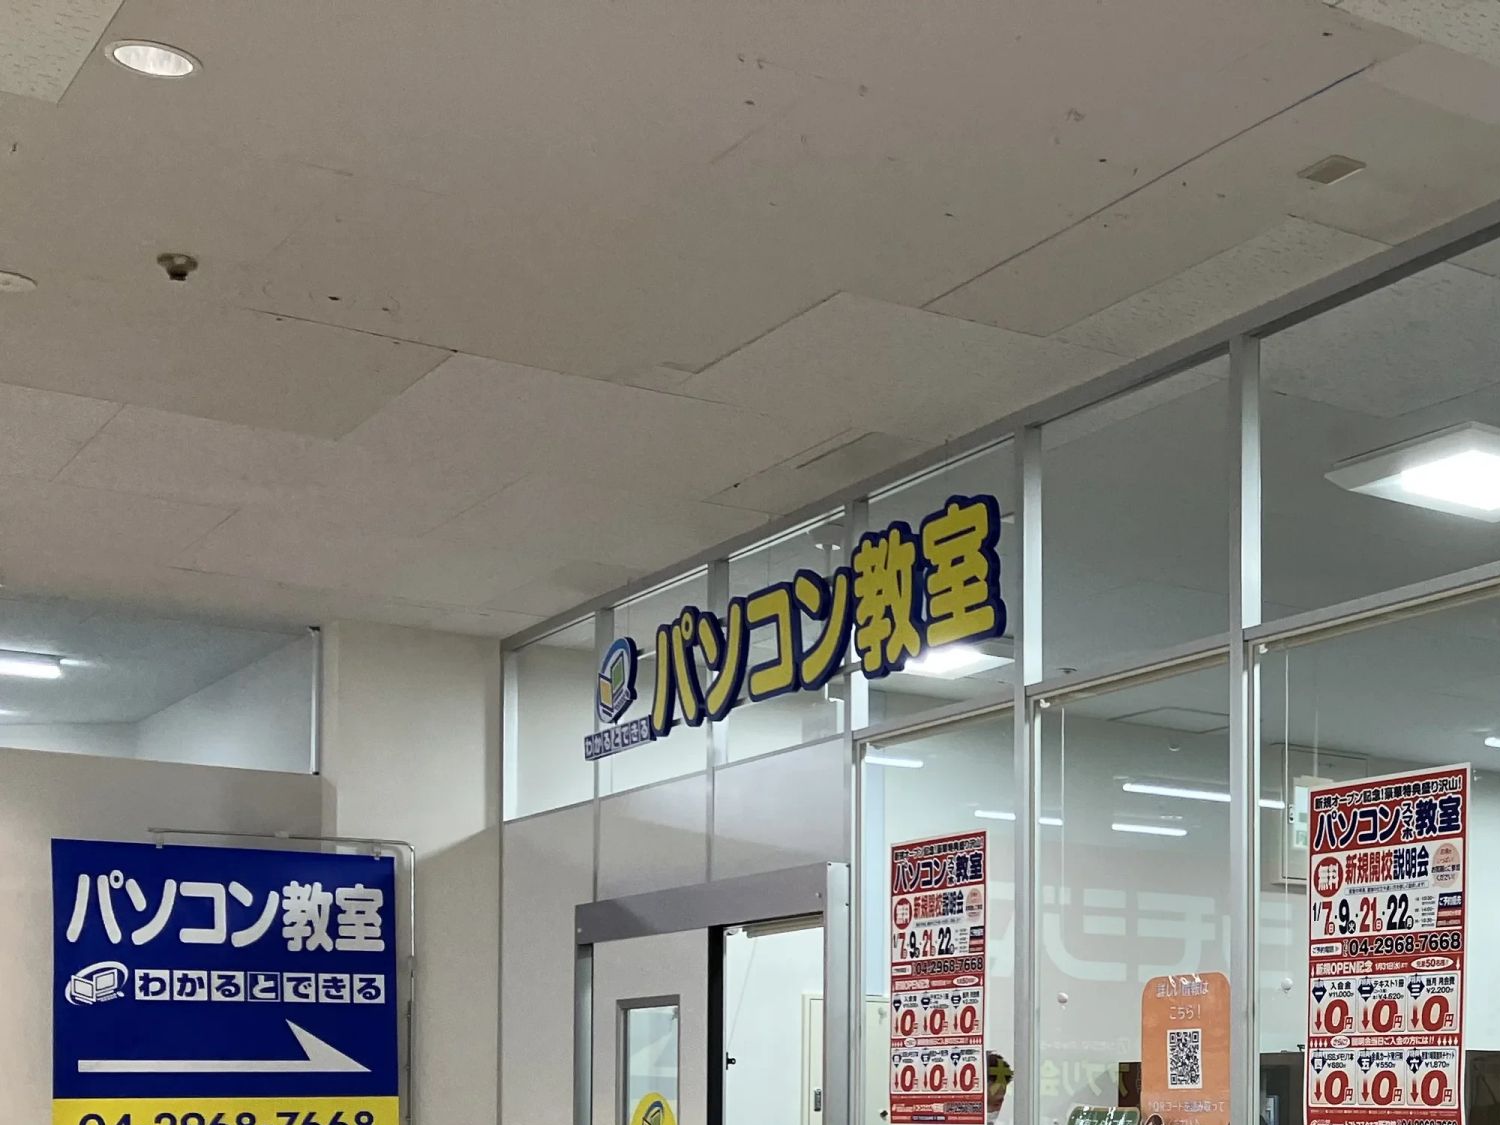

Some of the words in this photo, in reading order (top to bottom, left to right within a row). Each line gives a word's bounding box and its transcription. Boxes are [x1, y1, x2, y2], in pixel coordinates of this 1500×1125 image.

[652, 495, 1005, 736] パソコン教室
[1317, 863, 1339, 891] 無料
[1345, 845, 1429, 885] 新規開校説明会
[66, 870, 386, 952] パソコン教室
[1350, 932, 1462, 957] 04-2968-7668
[135, 969, 385, 1004] わかるとできる
